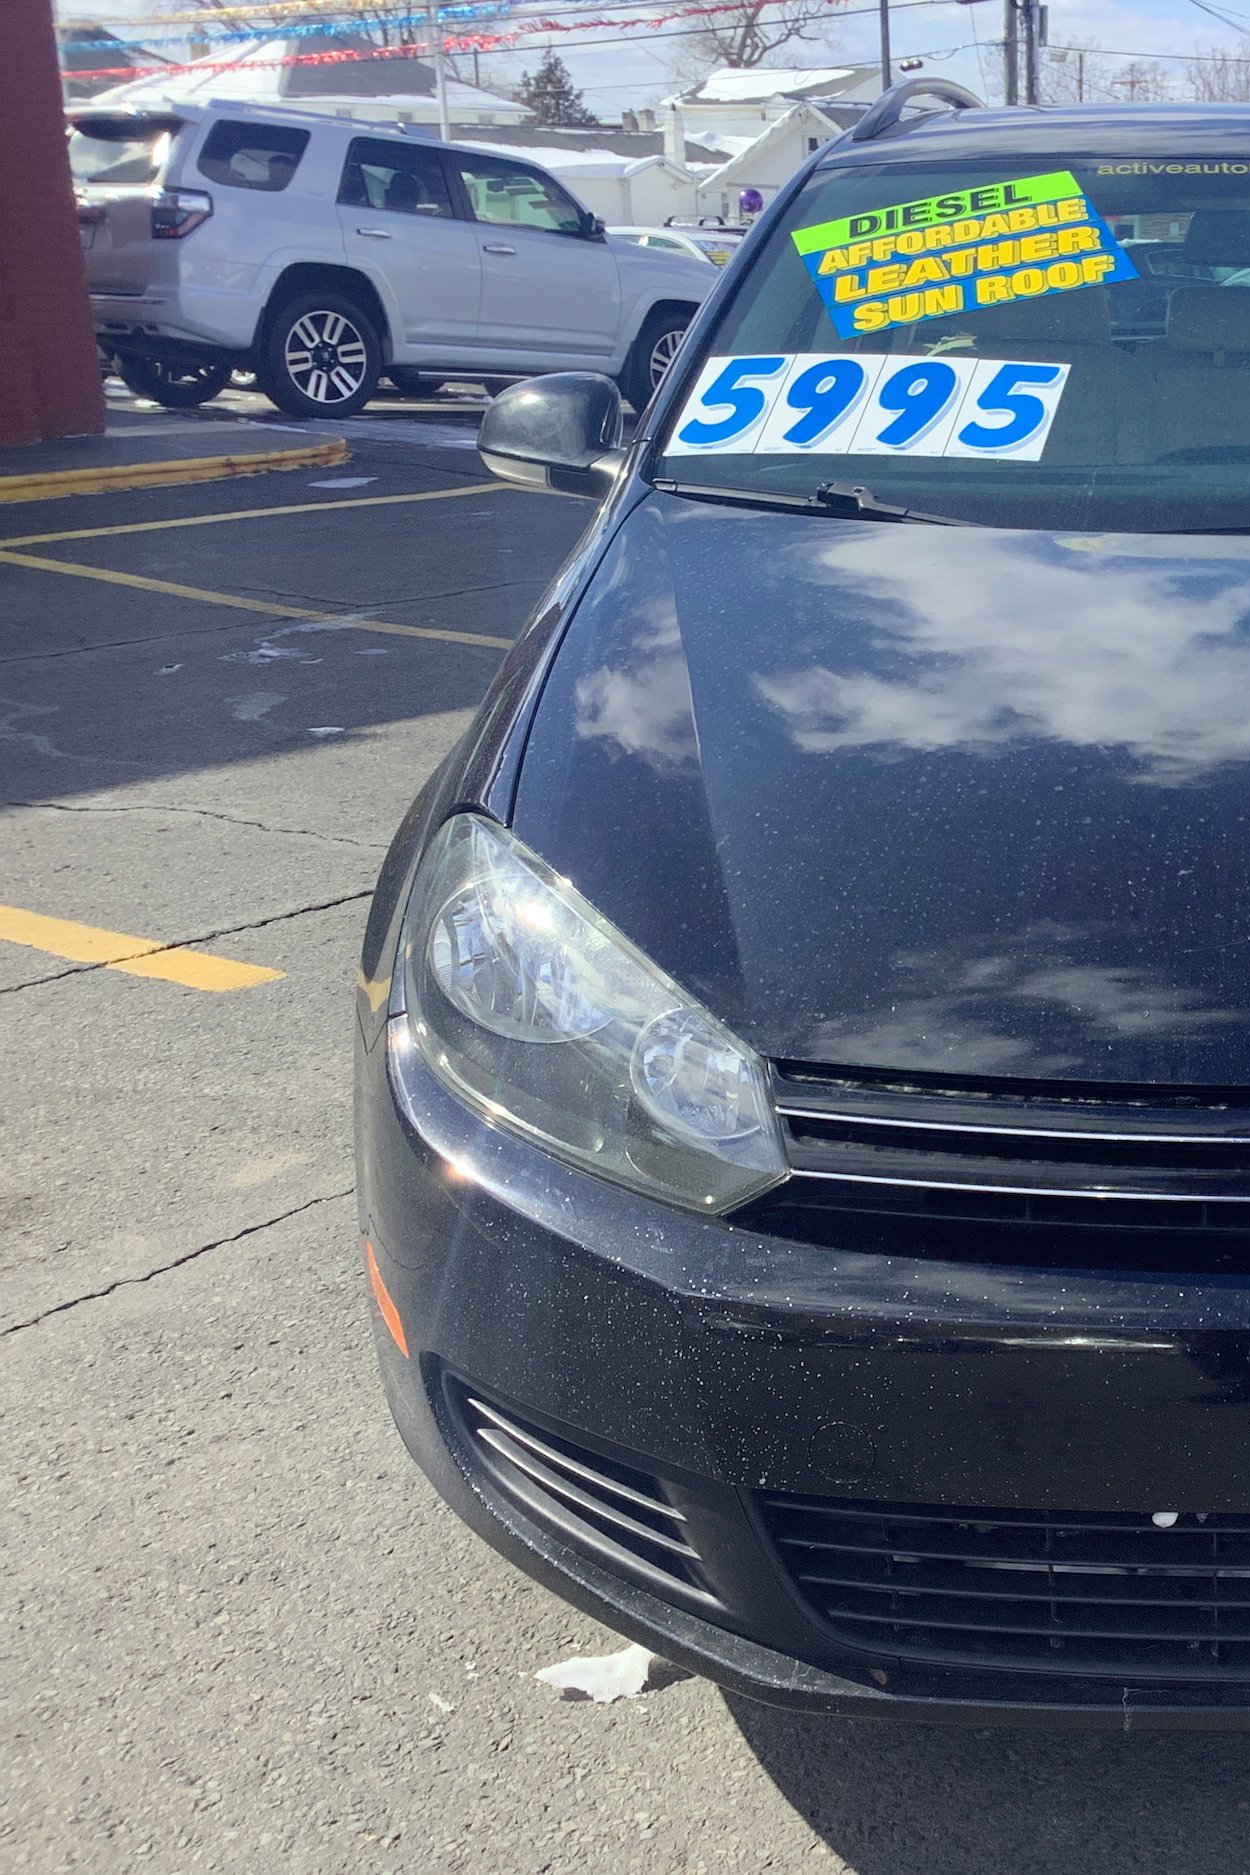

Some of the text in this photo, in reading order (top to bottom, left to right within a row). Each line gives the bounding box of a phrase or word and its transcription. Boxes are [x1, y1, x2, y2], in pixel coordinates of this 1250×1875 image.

[817, 198, 1089, 275] AFFORDABLE
[848, 184, 1033, 239] DIESEL
[833, 225, 1102, 303] LEATHER
[852, 255, 1116, 331] SUN ROOF
[679, 357, 1063, 451] 5995
